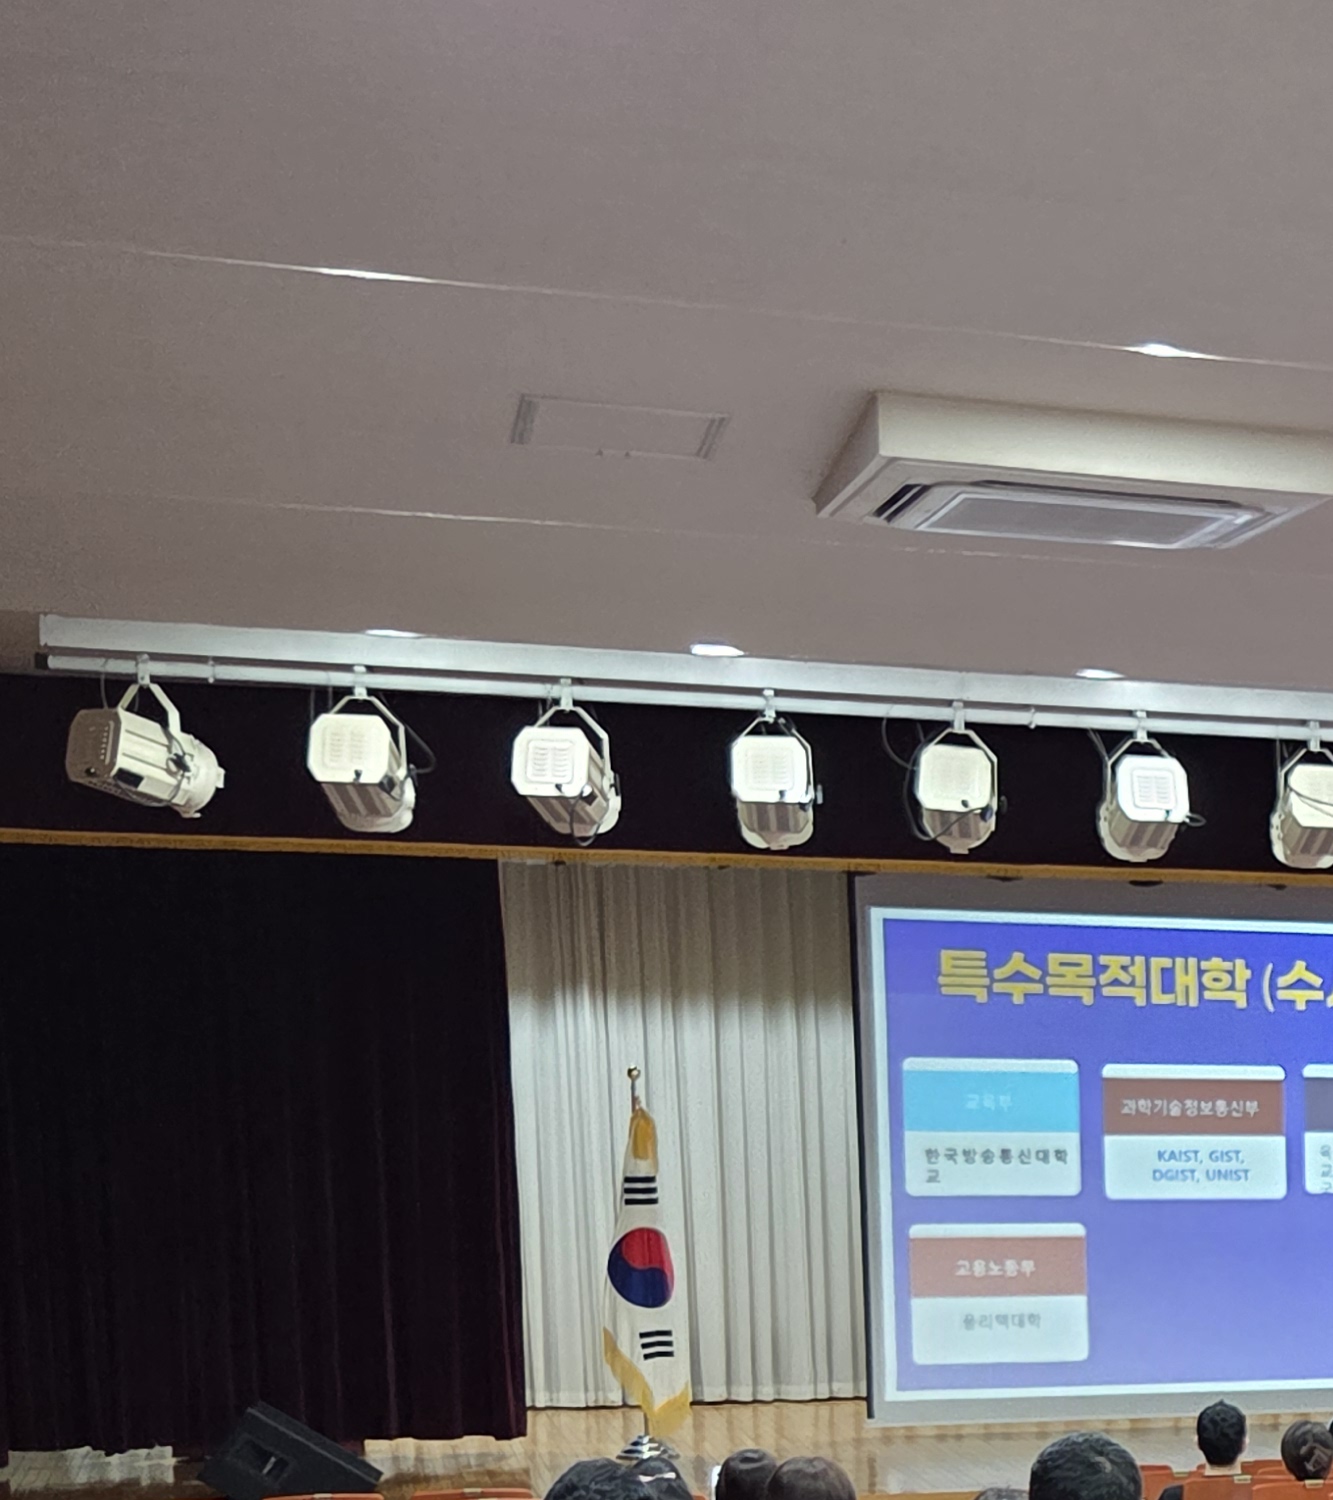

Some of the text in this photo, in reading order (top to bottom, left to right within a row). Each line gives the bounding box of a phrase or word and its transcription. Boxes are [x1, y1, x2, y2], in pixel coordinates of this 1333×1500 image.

[938, 949, 1252, 1010] 특수목적대학
[1121, 1098, 1260, 1118] 과학기술정보통신부
[924, 1147, 1069, 1165] 한국방송통신대학
[1157, 1149, 1245, 1164] KAIST, GIST,
[925, 1169, 941, 1183] 교
[1152, 1168, 1250, 1183] DGIST, UNIST
[955, 1259, 1036, 1278] 고용노동부
